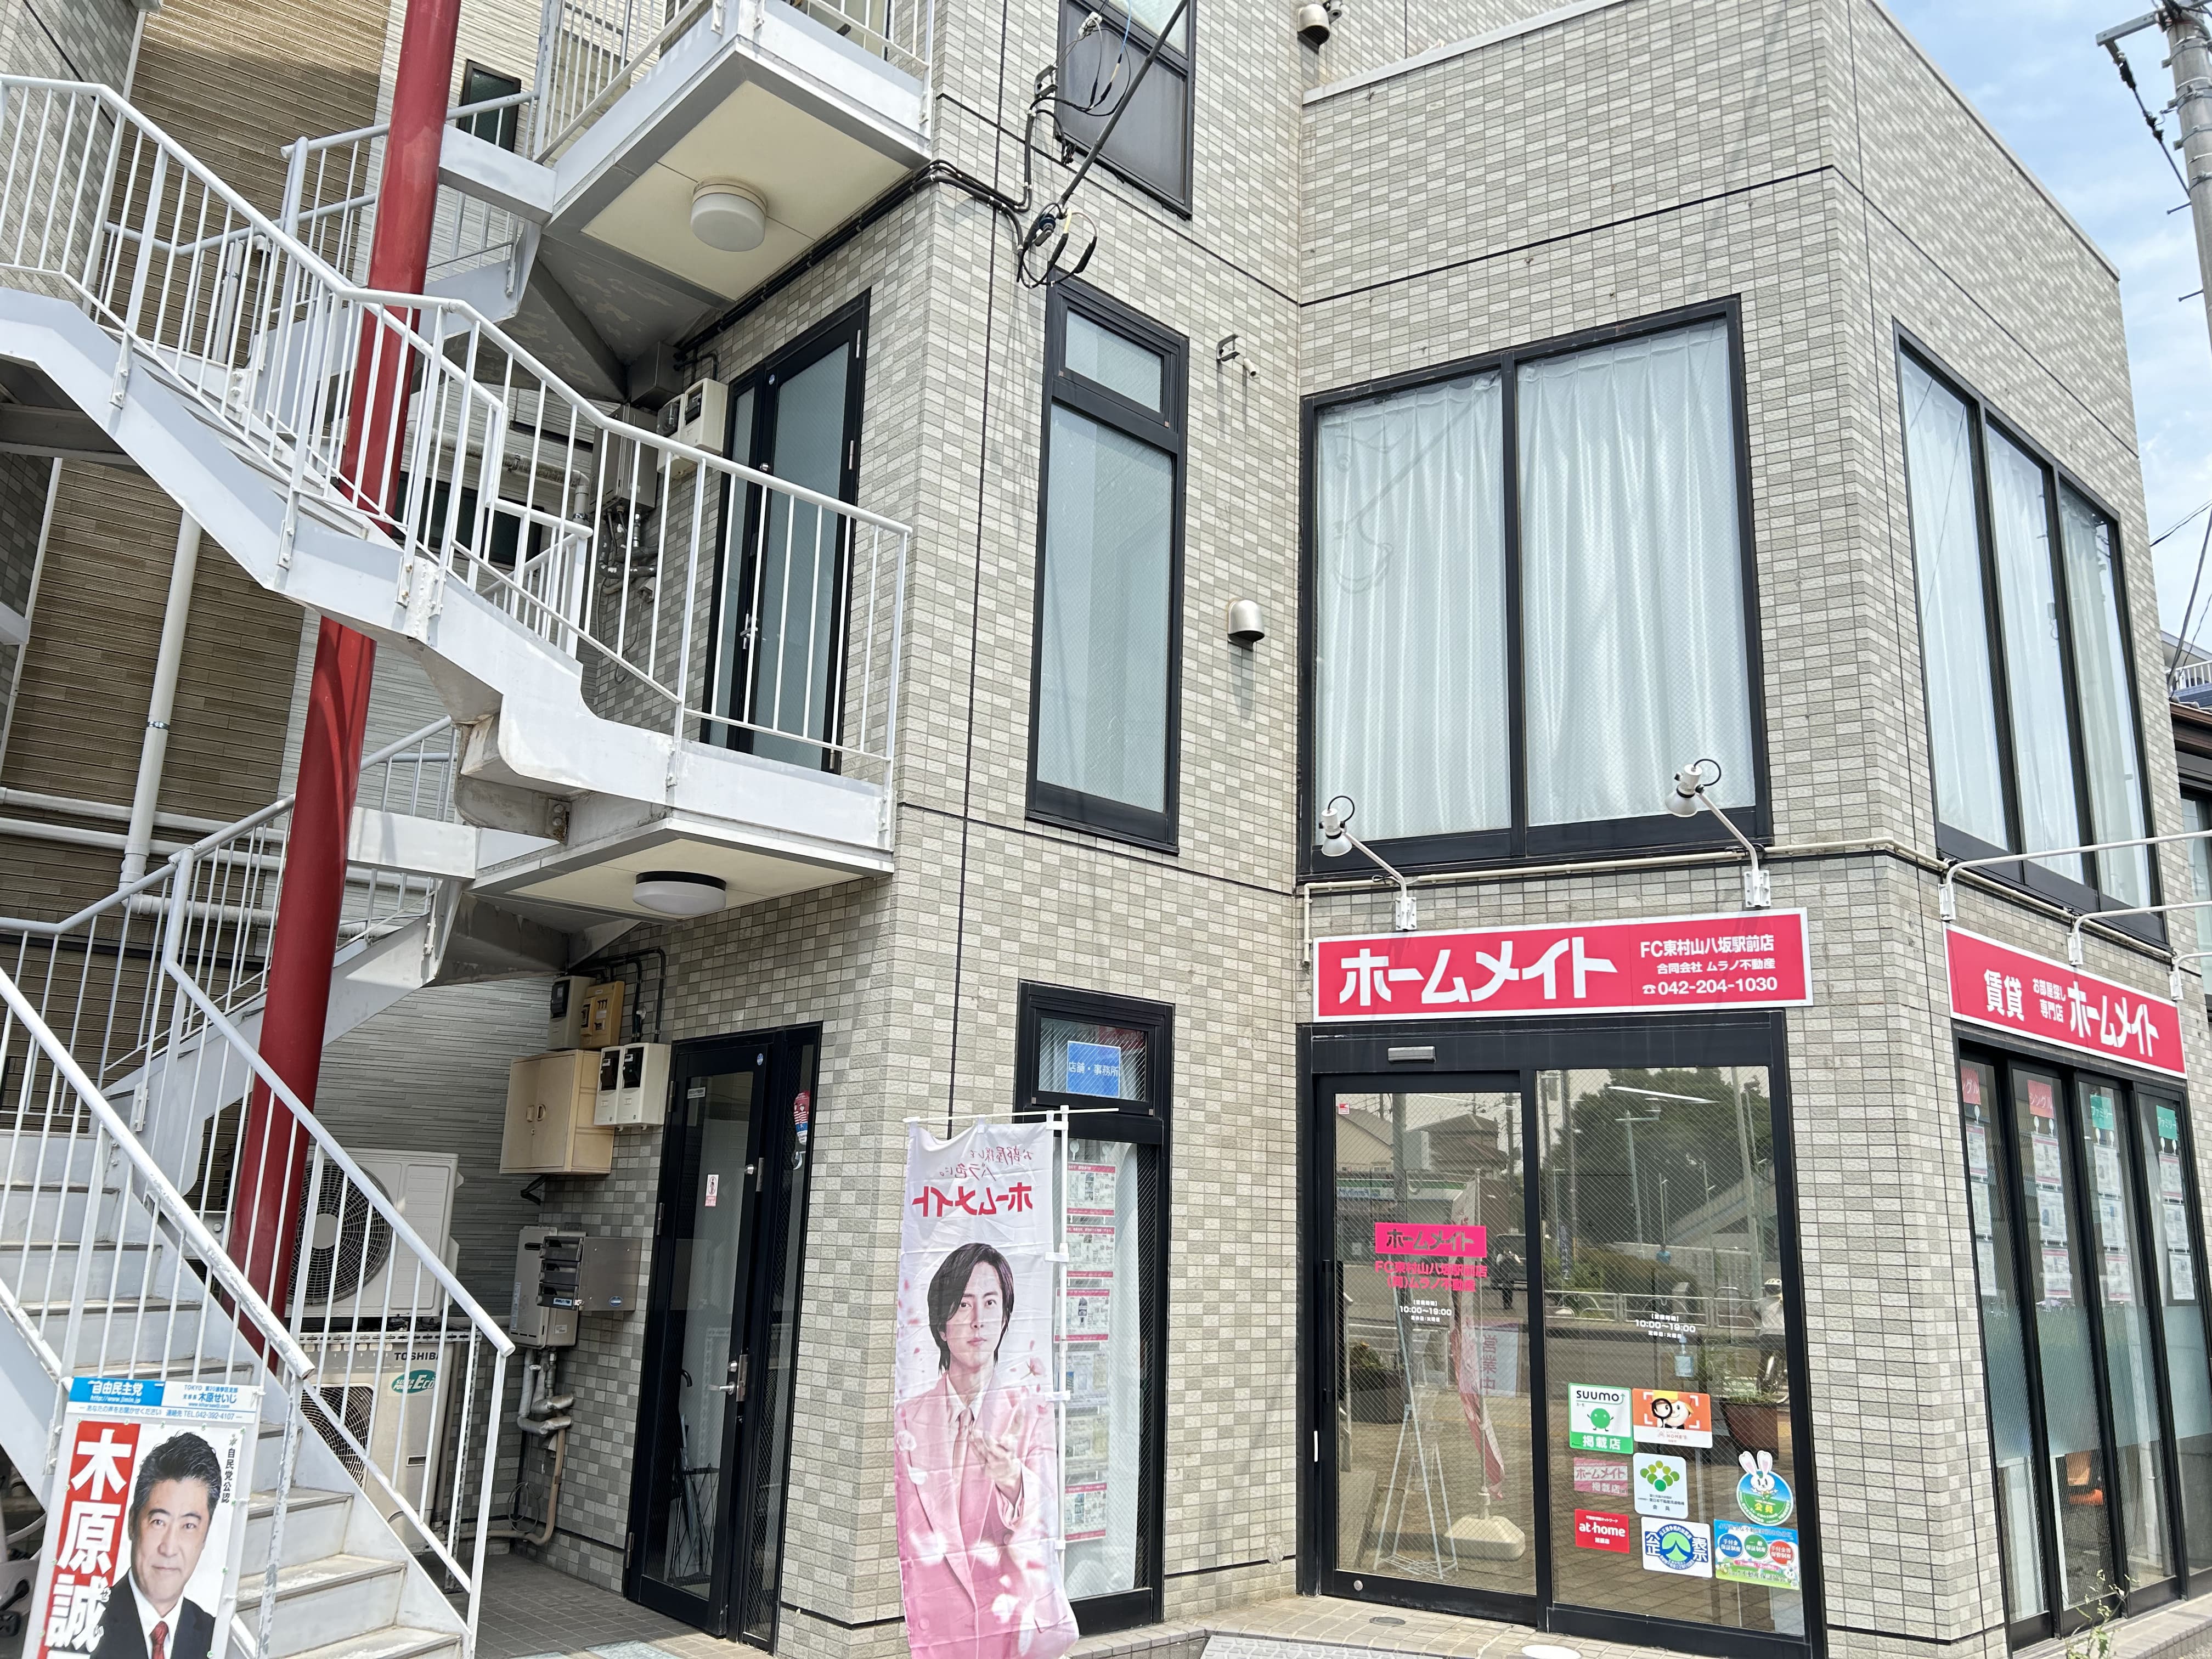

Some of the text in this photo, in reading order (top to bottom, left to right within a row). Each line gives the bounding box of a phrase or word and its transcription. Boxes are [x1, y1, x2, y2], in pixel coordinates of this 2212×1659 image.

[1640, 934, 1774, 958] FC東村山八坂駅前店
[1339, 937, 1618, 1006] ホームメイト
[1657, 958, 1776, 975] 合同会社 ムラノ不動産
[1657, 977, 1778, 995] 042-204-1030
[2033, 978, 2066, 1001] お部屋探し
[1984, 969, 2024, 1021] 賃貸
[2040, 999, 2064, 1023] 専門店
[2067, 981, 2160, 1057] ホームメイト
[1069, 1062, 1119, 1077] 店舗・事務所
[2029, 1093, 2053, 1109] シングル
[2157, 1116, 2176, 1129] ファミリー
[1386, 1228, 1474, 1251] ホームメイト
[1375, 1261, 1488, 1278] FC東村山八坂駅前店
[92, 1381, 144, 1396] 自由民主党
[198, 1392, 237, 1404] 木原せいじ
[1582, 1435, 1621, 1451] 掲載店
[221, 1448, 235, 1503] 自民党公認
[1576, 1468, 1626, 1480] ホームメイト
[1592, 1481, 1620, 1493] 掲載店
[44, 1428, 133, 1659] 木原誠
